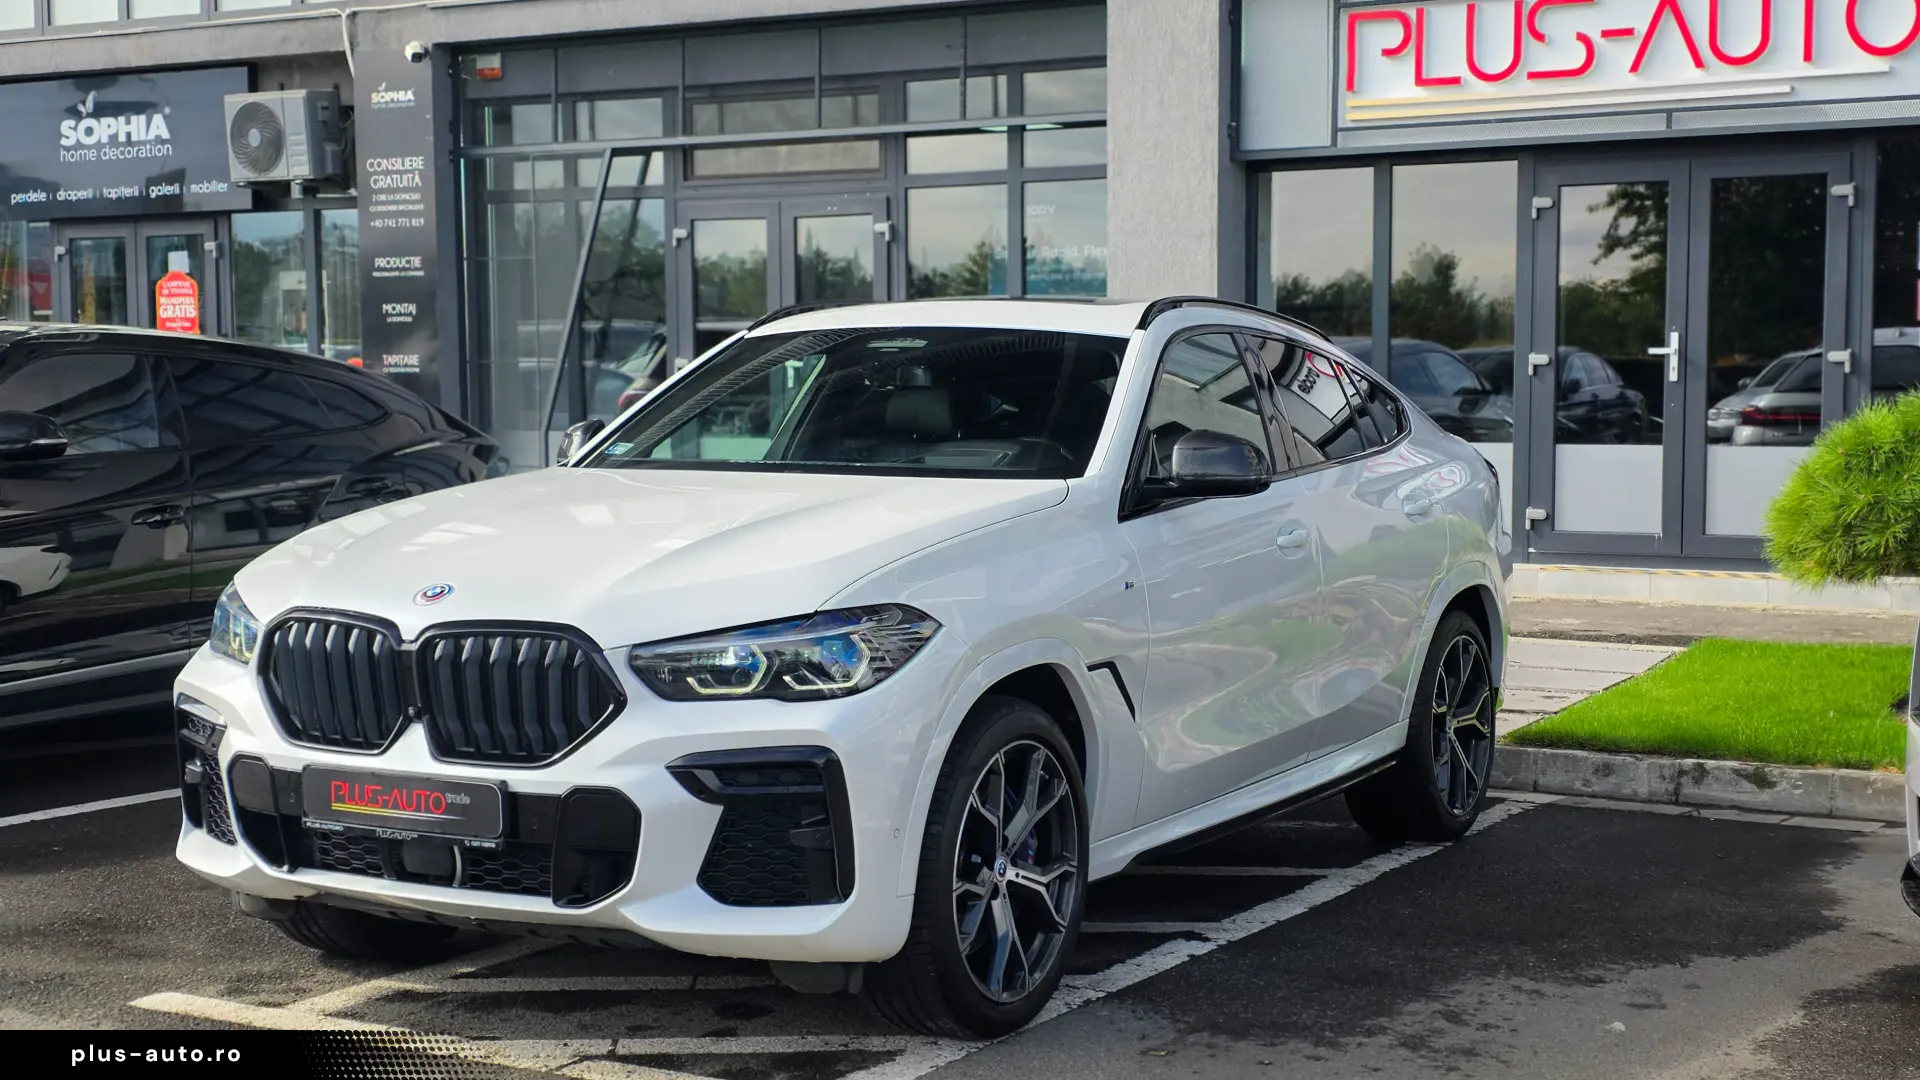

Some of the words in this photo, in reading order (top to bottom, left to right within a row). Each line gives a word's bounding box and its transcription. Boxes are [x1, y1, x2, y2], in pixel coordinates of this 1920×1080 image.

[371, 90, 415, 103] SOPHIA
[59, 112, 170, 147] SOPHIA
[60, 147, 97, 163] home
[101, 143, 172, 160] decoration
[366, 156, 425, 172] CONSILIERE
[370, 170, 422, 189] GRATUITĂ
[11, 188, 47, 205] perdele
[56, 187, 93, 202] draperii
[149, 182, 180, 198] galerii
[190, 179, 228, 193] mobilier
[159, 304, 197, 319] GRATIS
[382, 303, 417, 316] MONTAJ
[330, 780, 447, 815] PLUS-AUTO
[444, 792, 471, 805] trade
[376, 829, 412, 840] PLUS-AUTO
